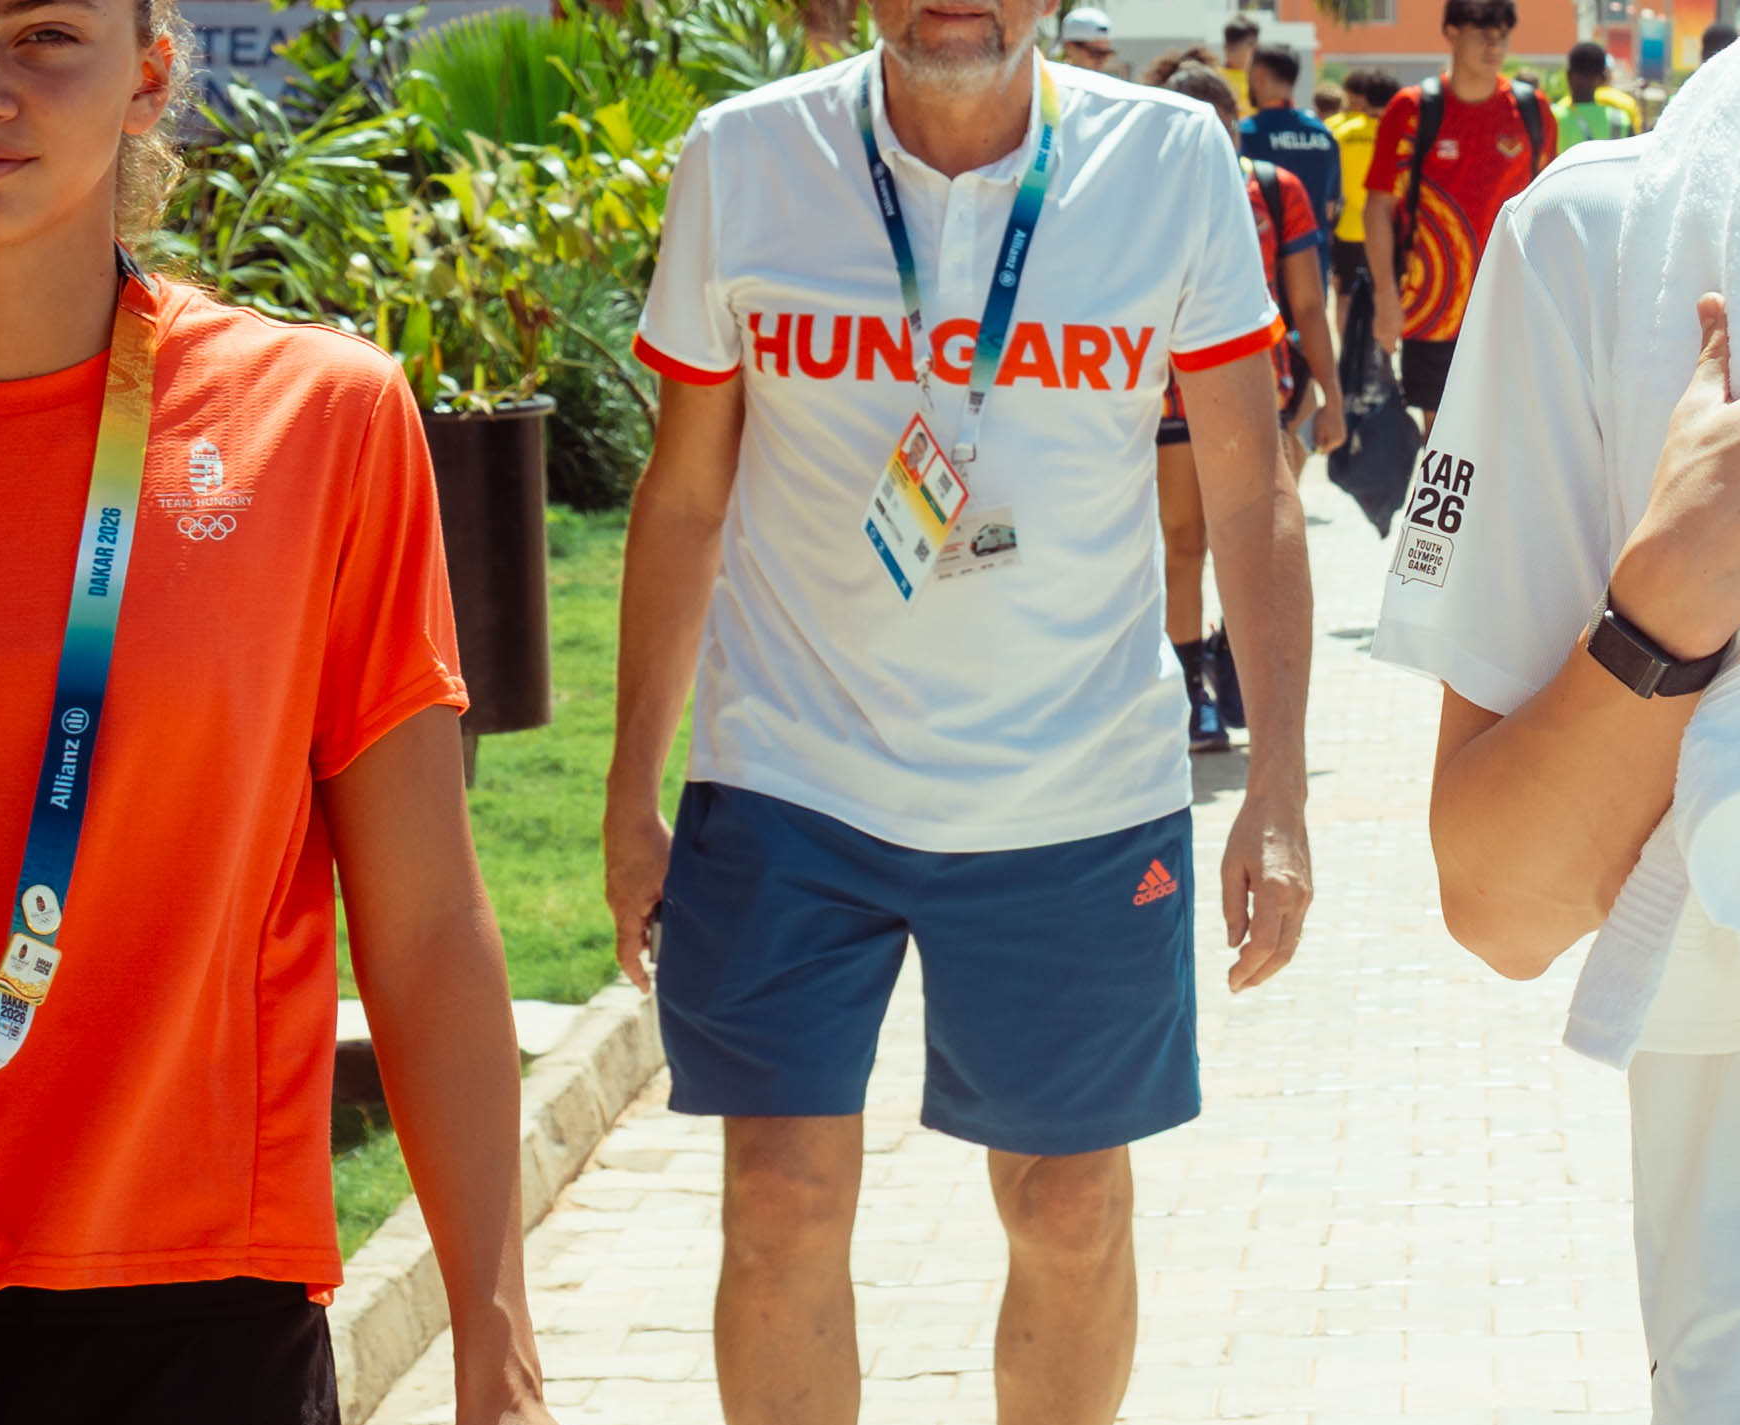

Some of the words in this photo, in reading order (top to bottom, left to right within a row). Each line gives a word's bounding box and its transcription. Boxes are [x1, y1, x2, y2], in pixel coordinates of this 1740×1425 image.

[746, 312, 1155, 390] HUNGARY
[160, 497, 192, 509] TEAM
[195, 495, 253, 508] HUNGARY
[1405, 487, 1465, 534] 26
[98, 507, 122, 546] 2026
[1408, 548, 1444, 566] OLYMPIC
[1416, 538, 1442, 554] YOUTH
[88, 547, 116, 597] DAKAR
[1408, 560, 1437, 576] GAMES
[50, 739, 81, 810] Allianz
[1133, 879, 1178, 907] adidas
[0, 1006, 26, 1025] 2026
